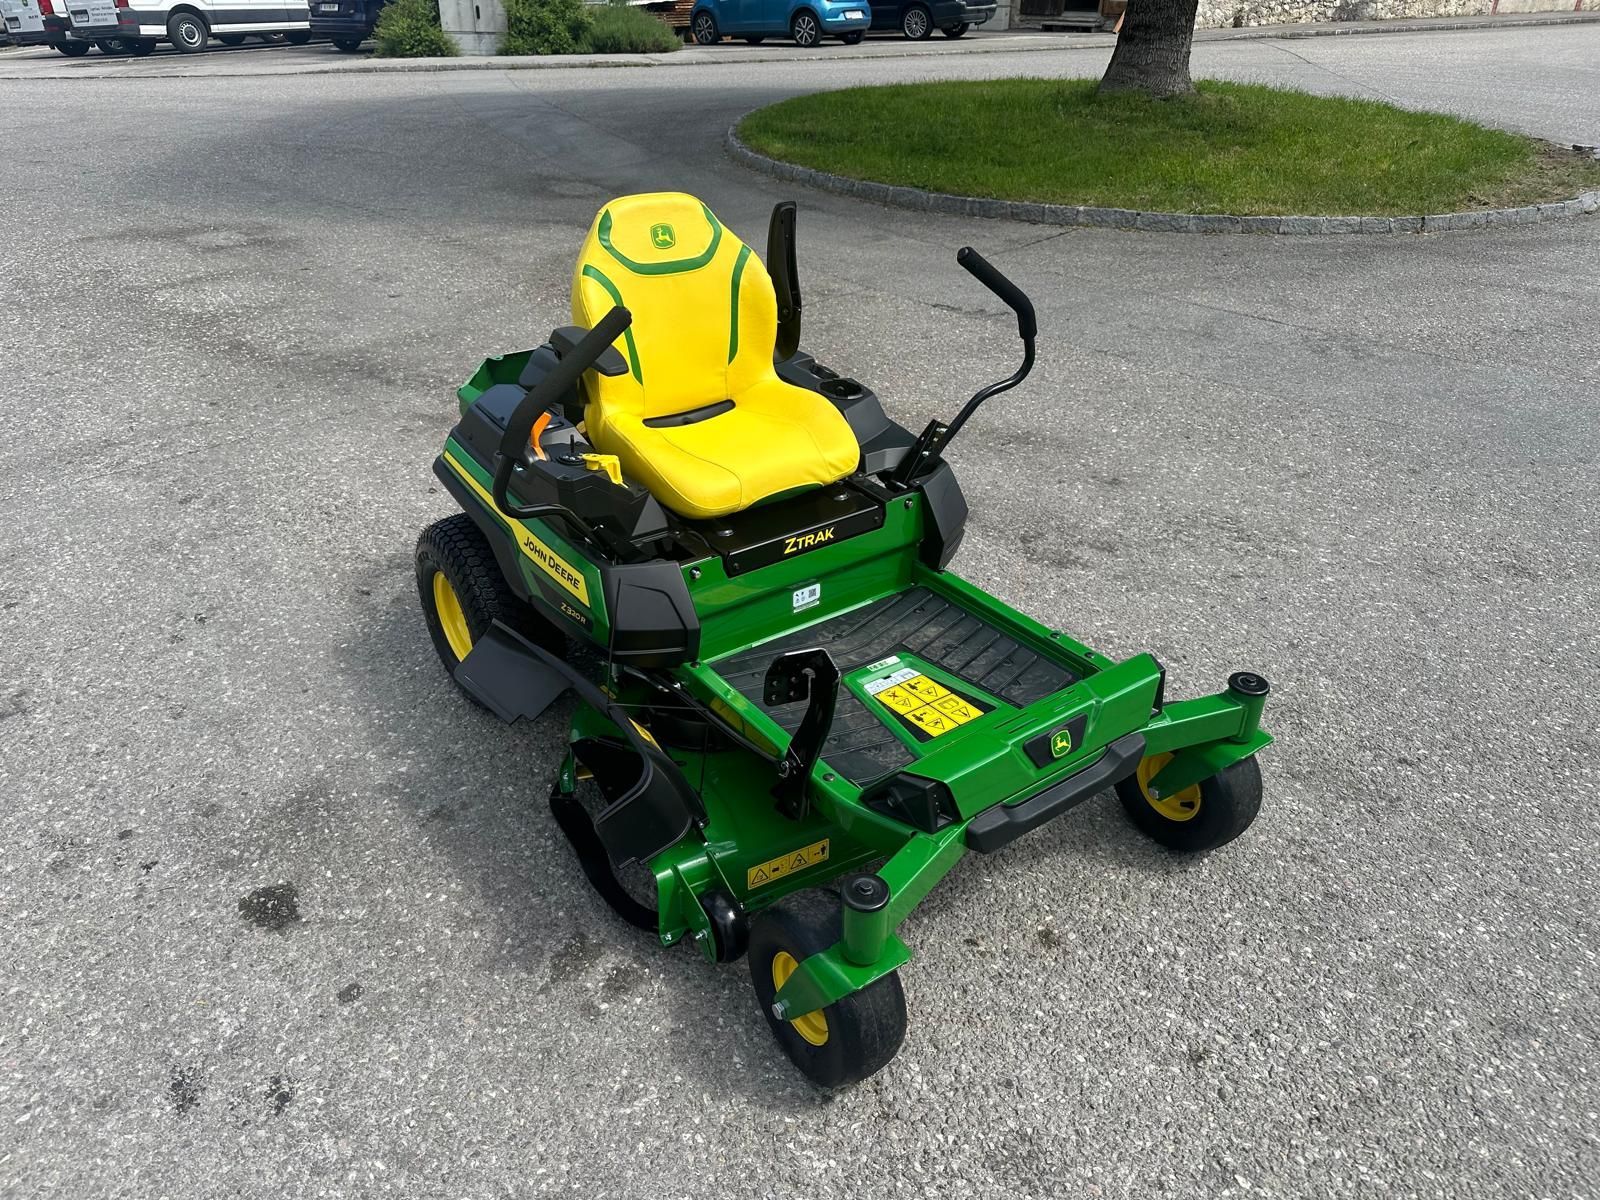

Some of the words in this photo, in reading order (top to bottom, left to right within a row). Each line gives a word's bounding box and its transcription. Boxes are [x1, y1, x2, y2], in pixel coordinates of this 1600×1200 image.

[783, 526, 835, 555] ZTRAK
[523, 536, 547, 563] JOHN
[548, 556, 580, 590] DEERE
